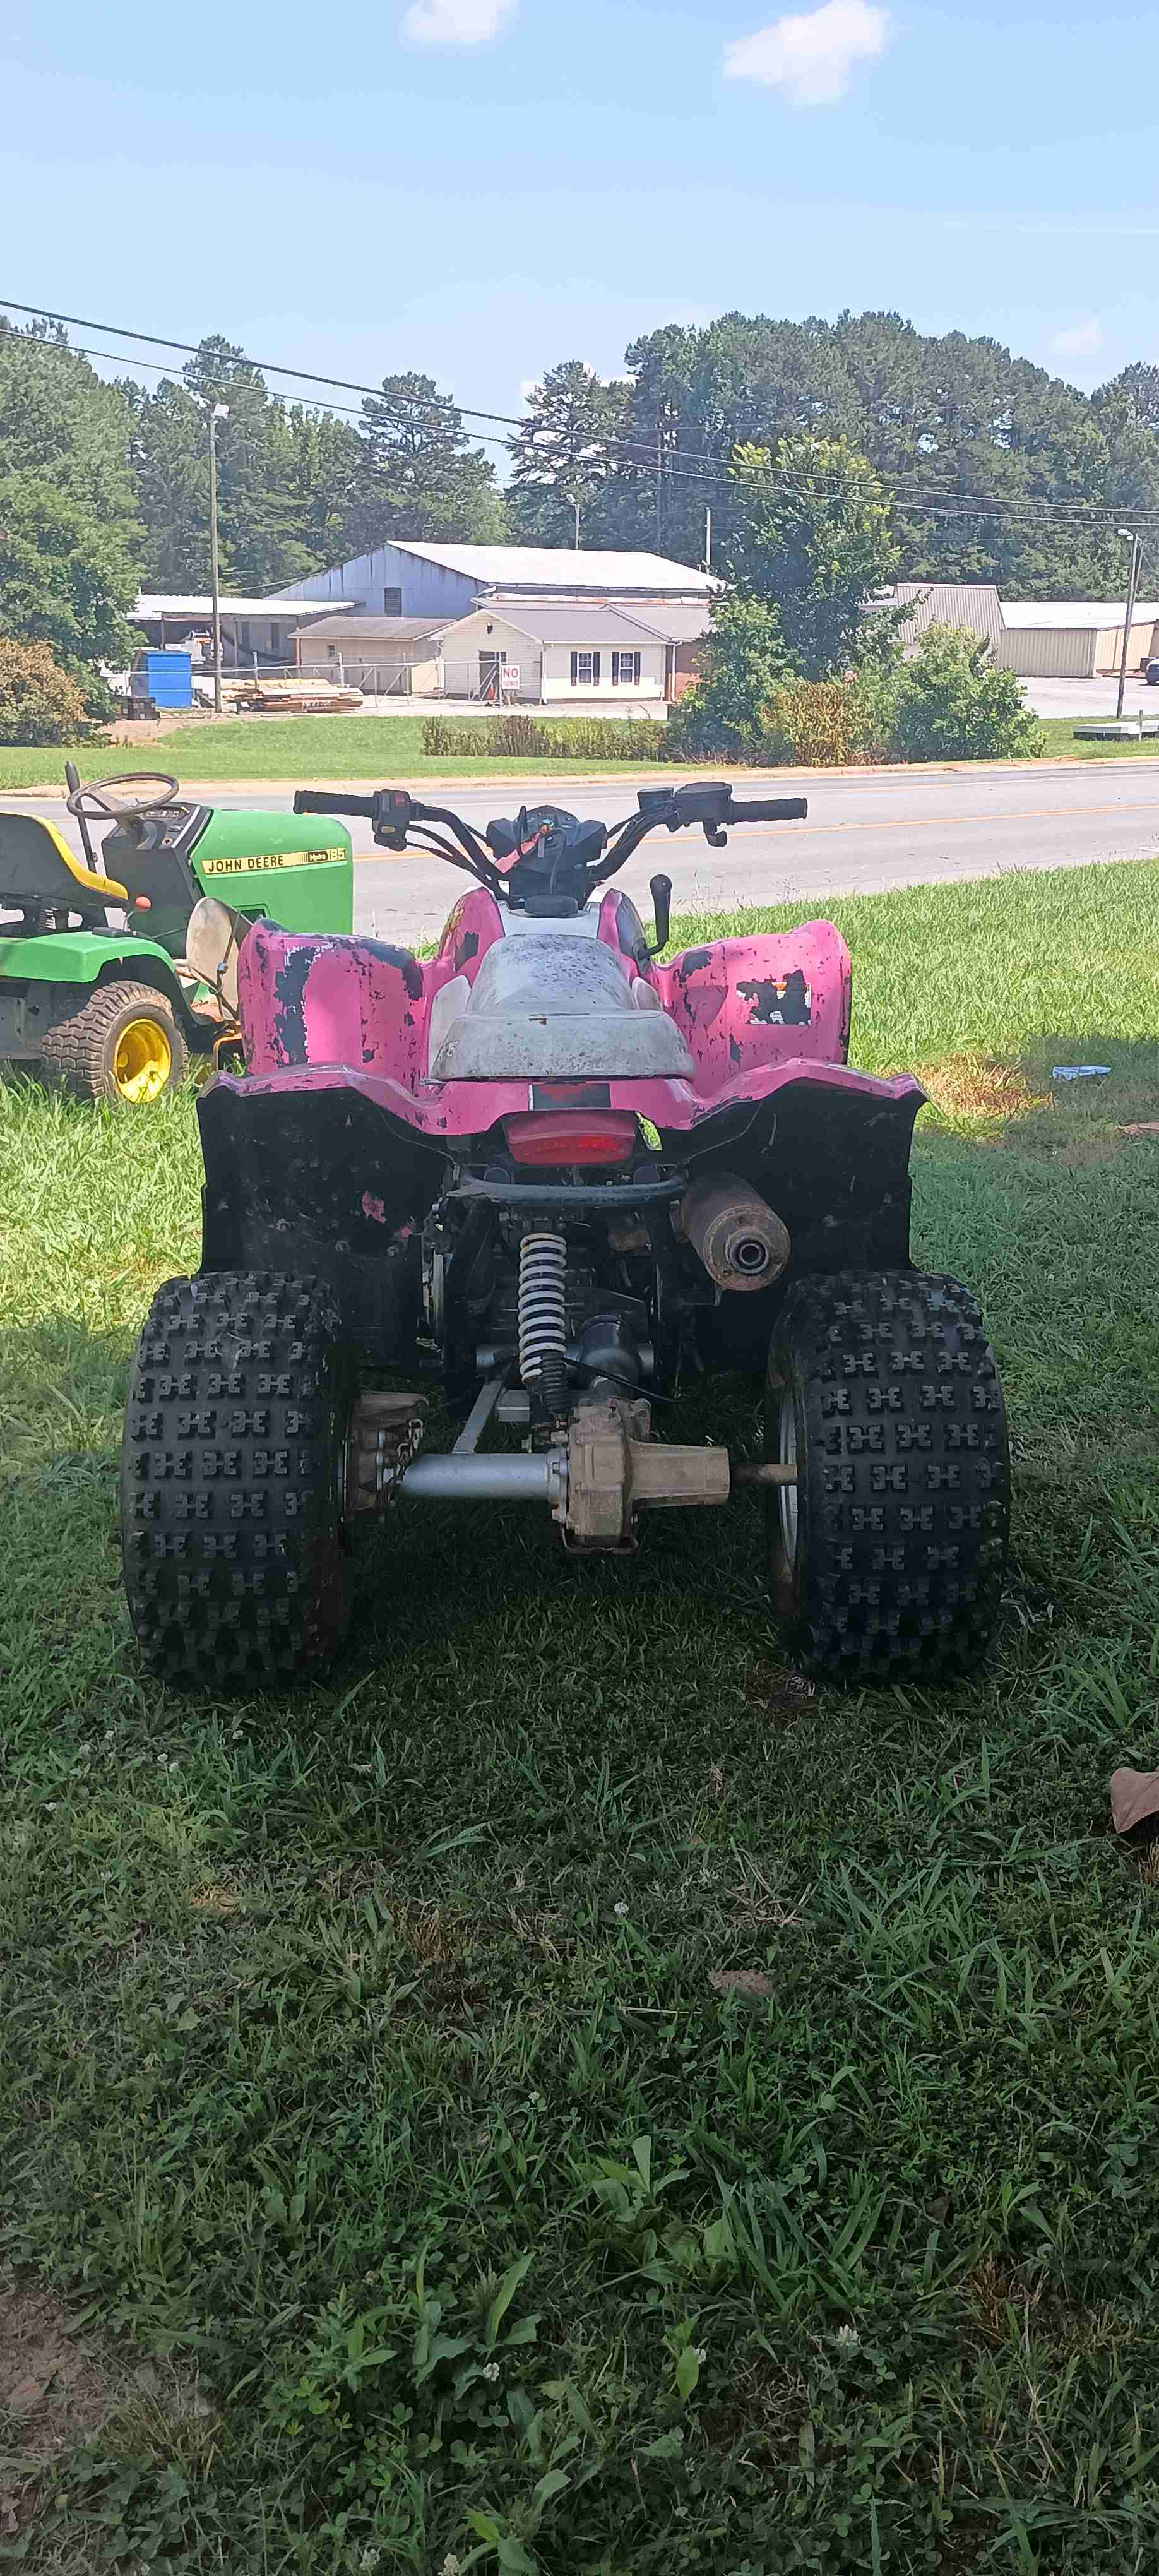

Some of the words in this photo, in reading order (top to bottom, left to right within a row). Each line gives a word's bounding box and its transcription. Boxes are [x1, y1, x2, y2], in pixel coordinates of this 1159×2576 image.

[503, 667, 518, 678] NO
[208, 860, 242, 872] JOHN
[247, 855, 283, 869] DEERE
